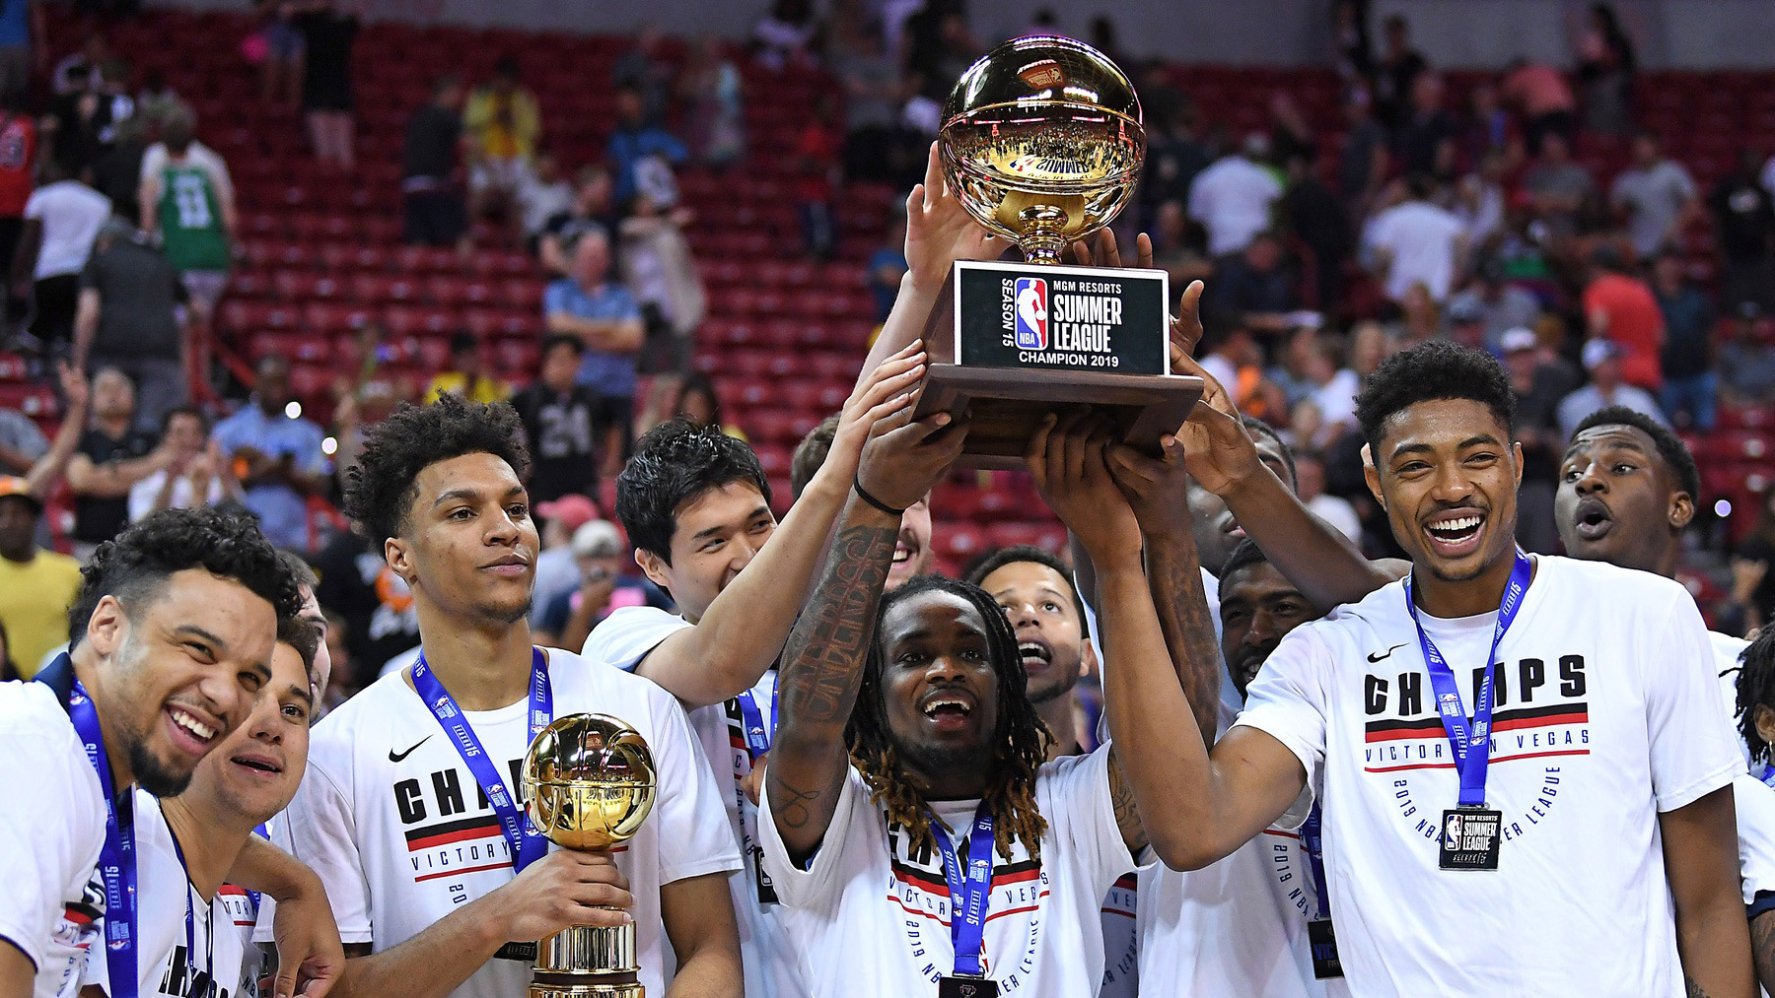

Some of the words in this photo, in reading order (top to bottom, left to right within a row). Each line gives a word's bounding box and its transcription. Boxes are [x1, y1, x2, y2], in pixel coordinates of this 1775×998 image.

[1053, 280, 1076, 292] MGM
[1079, 281, 1122, 294] RESORTS
[1002, 278, 1014, 331] SEASON
[1053, 294, 1123, 325] SUMMER
[1002, 332, 1014, 347] 15
[1019, 332, 1035, 345] NBA
[1054, 322, 1112, 353] LEAGUE
[1018, 351, 1087, 366] CHAMPION
[1090, 355, 1119, 368] 2019
[1365, 654, 1587, 716] CHMPS
[465, 746, 481, 757] 15
[1366, 743, 1443, 762] VICTOR
[1516, 729, 1590, 749] VEGAS
[1394, 780, 1417, 818] 2019
[1525, 767, 1561, 825] LEAGUE
[979, 820, 992, 831] 15
[1463, 822, 1498, 837] SUMMER
[411, 841, 511, 871] VICTORY
[1462, 837, 1491, 851] LEAGUE
[105, 866, 119, 878] 15
[1273, 844, 1293, 883] 2019
[449, 884, 467, 904] 20
[888, 875, 946, 916] VCTOR
[966, 913, 979, 926] 15
[906, 920, 926, 958] 2019
[922, 963, 943, 984] NB
